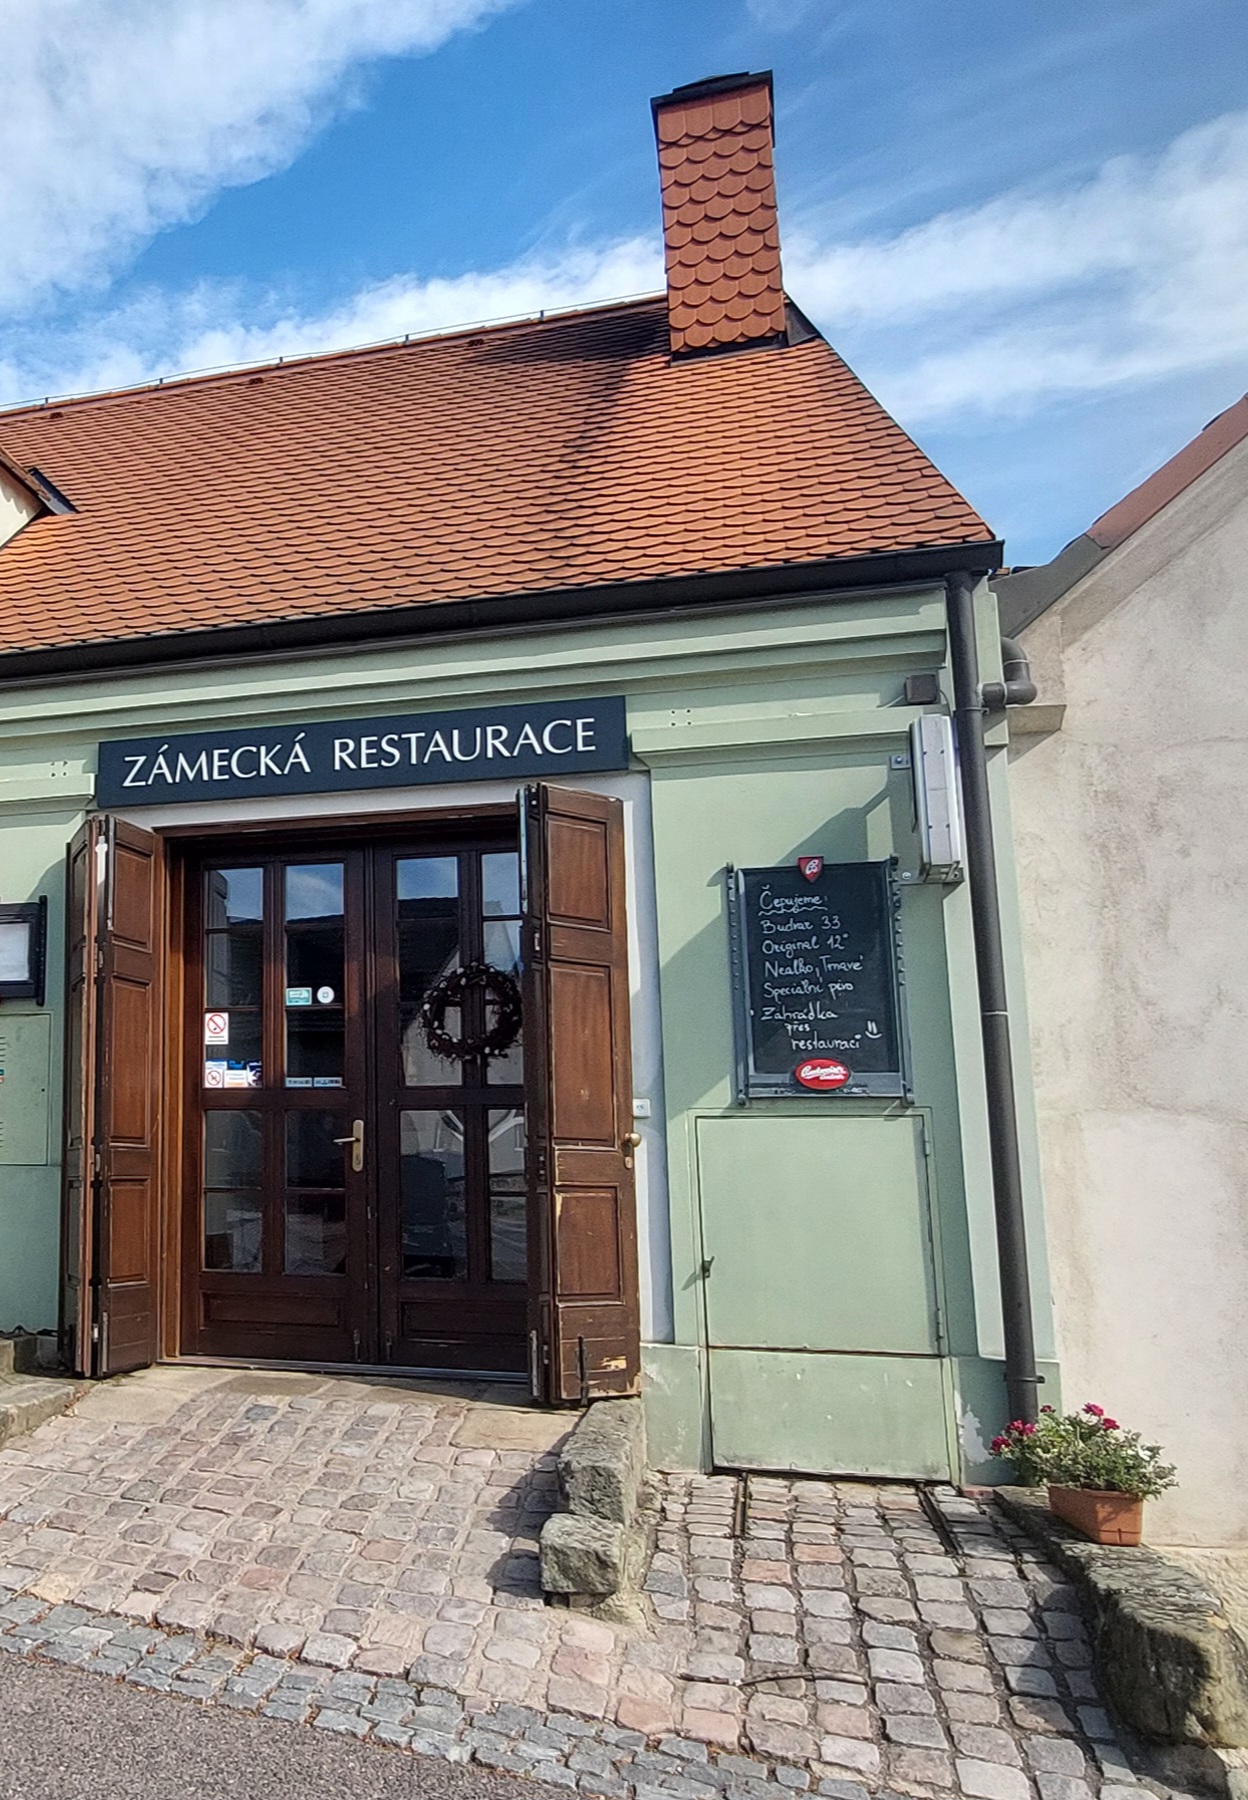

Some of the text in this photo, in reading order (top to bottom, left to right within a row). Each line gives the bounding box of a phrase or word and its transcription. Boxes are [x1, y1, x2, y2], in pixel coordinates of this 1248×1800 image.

[122, 717, 597, 788] ZÁMECKÁ RESTAURACE
[760, 915, 841, 934] Budvar 33
